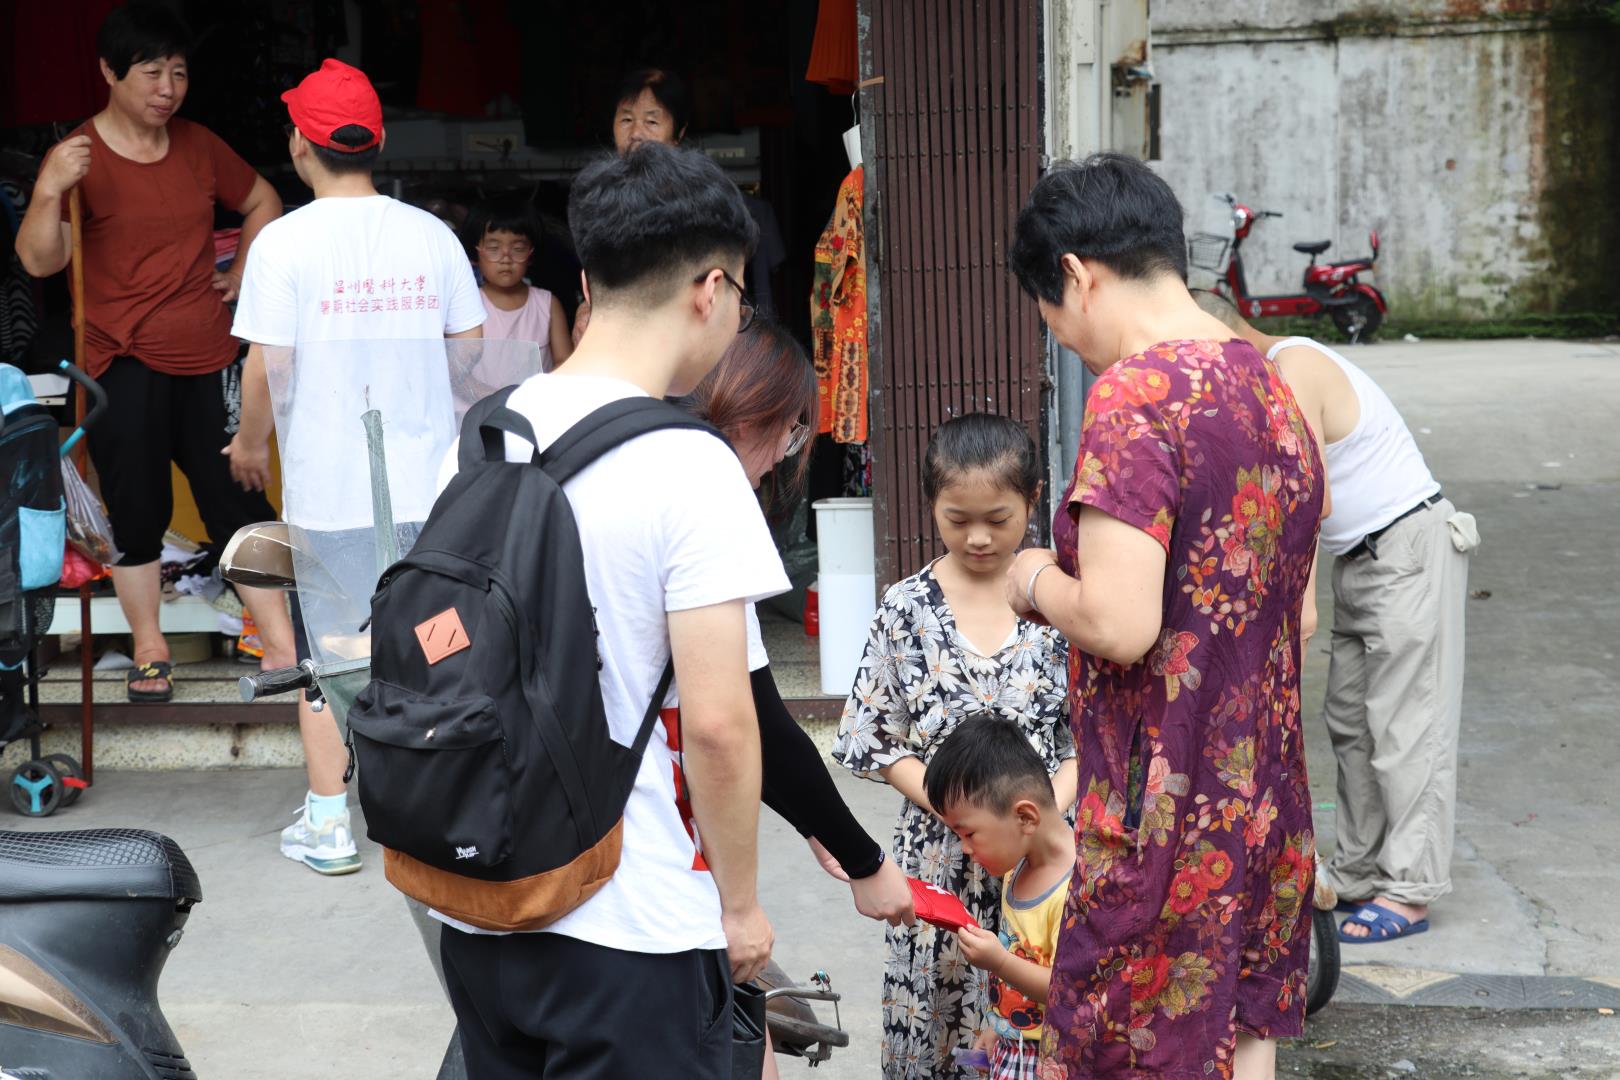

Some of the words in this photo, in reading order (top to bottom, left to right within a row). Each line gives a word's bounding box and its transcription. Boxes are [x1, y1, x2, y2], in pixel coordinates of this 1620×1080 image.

[320, 295, 440, 315] 暑期社会实践服务团
